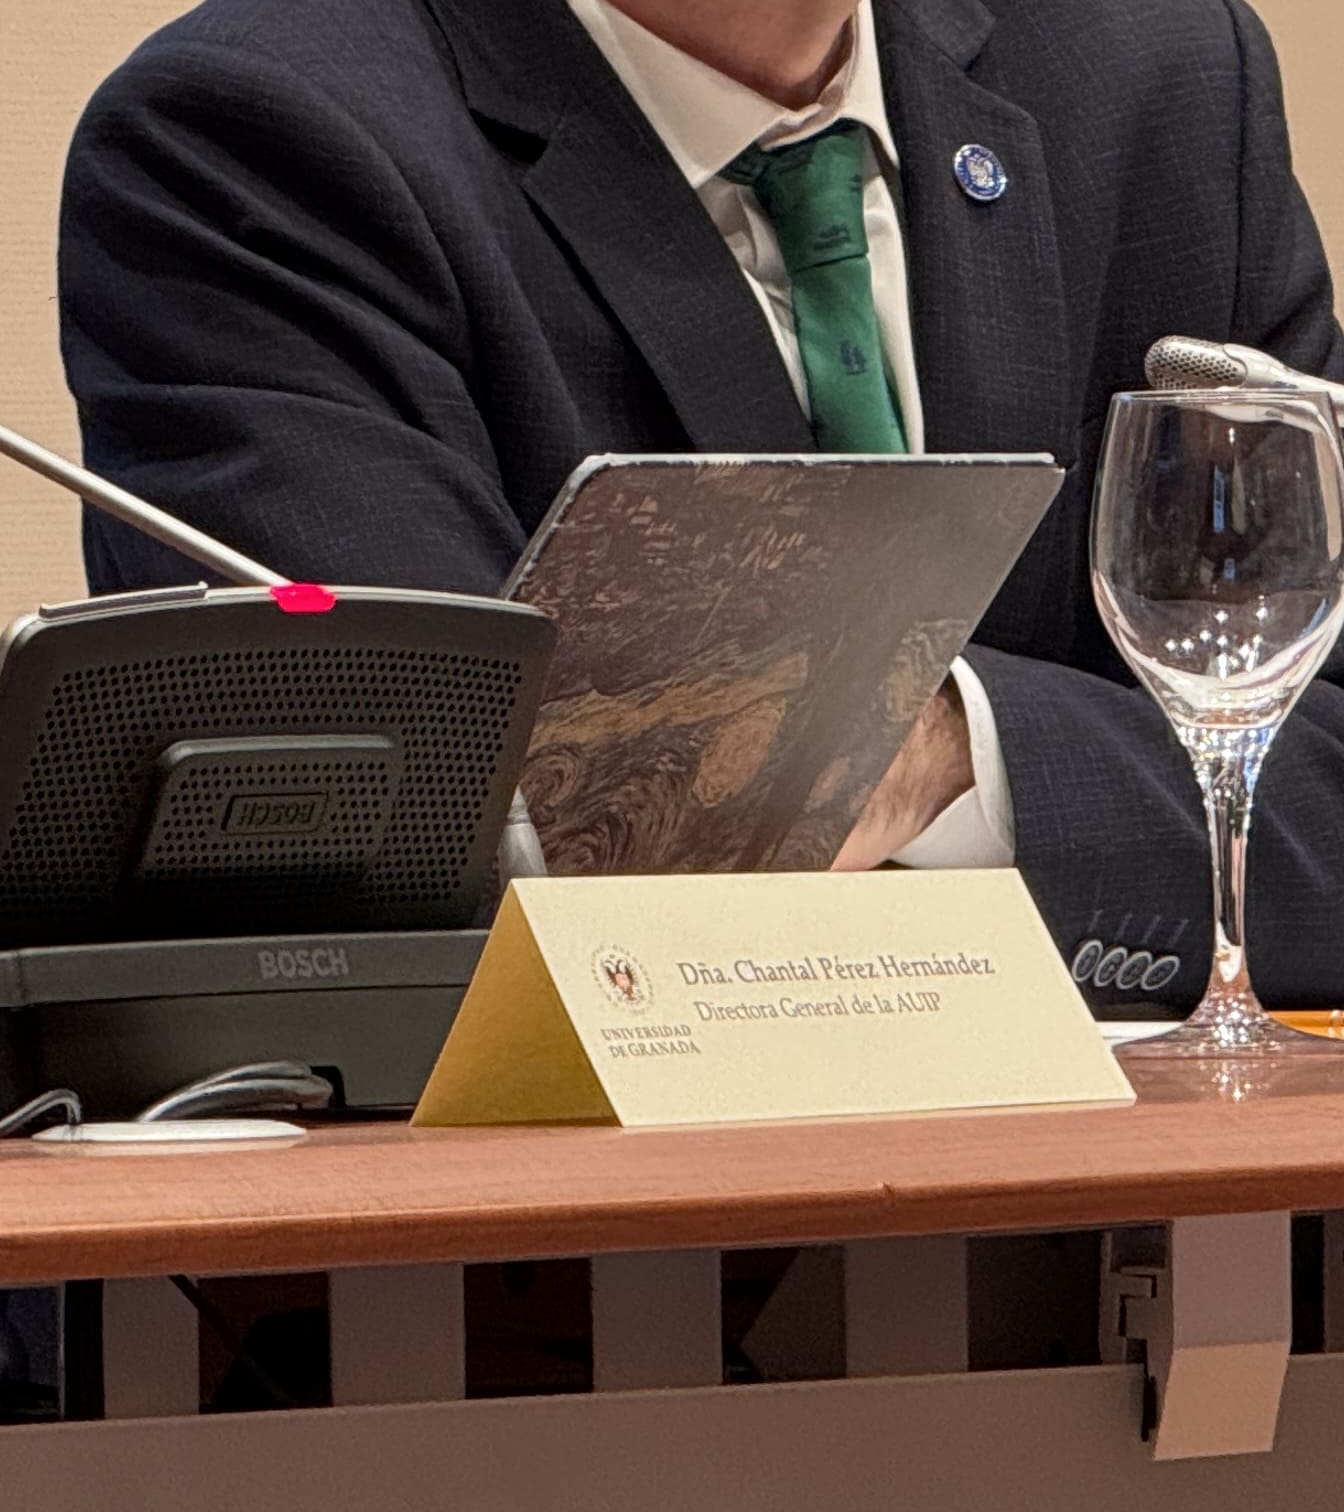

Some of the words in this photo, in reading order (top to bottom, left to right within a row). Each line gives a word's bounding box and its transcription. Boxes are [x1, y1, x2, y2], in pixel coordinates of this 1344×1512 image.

[257, 947, 349, 980] BOSCH
[676, 960, 733, 986] Dña.
[733, 956, 819, 984] Chantal
[817, 954, 881, 982] Pérez
[878, 952, 996, 979] Hernández
[694, 999, 780, 1023] Directora
[779, 995, 849, 1019] General
[851, 994, 873, 1015] de
[874, 993, 895, 1014] la
[600, 1024, 692, 1041] UNIVERSIDAD
[609, 1044, 629, 1059] DE
[627, 1040, 702, 1058] GRANADA
